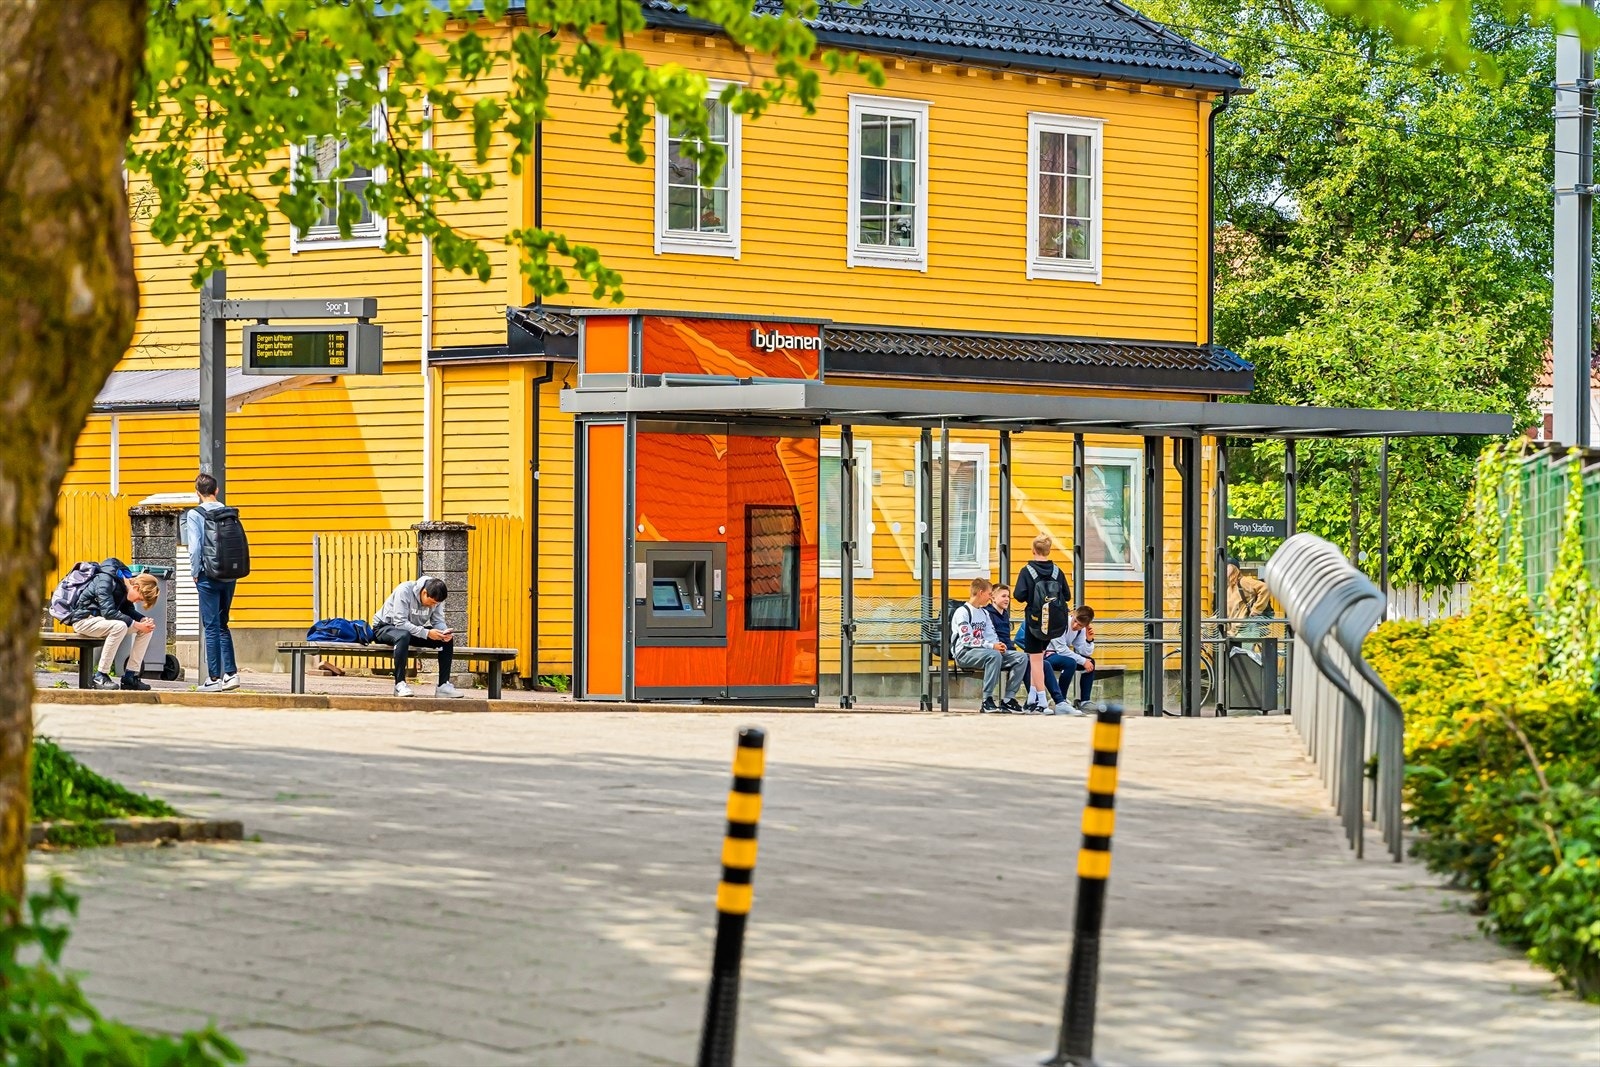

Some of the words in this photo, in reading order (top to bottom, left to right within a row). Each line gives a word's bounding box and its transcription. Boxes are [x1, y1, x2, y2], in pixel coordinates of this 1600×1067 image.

[326, 301, 342, 312] Spor
[343, 302, 350, 314] 1
[256, 334, 273, 343] Bergen
[273, 334, 293, 342] lufthavn
[755, 329, 822, 353] bybanen
[256, 342, 273, 350] Bergen
[256, 349, 273, 358] Bergen
[1252, 522, 1274, 532] Stadion
